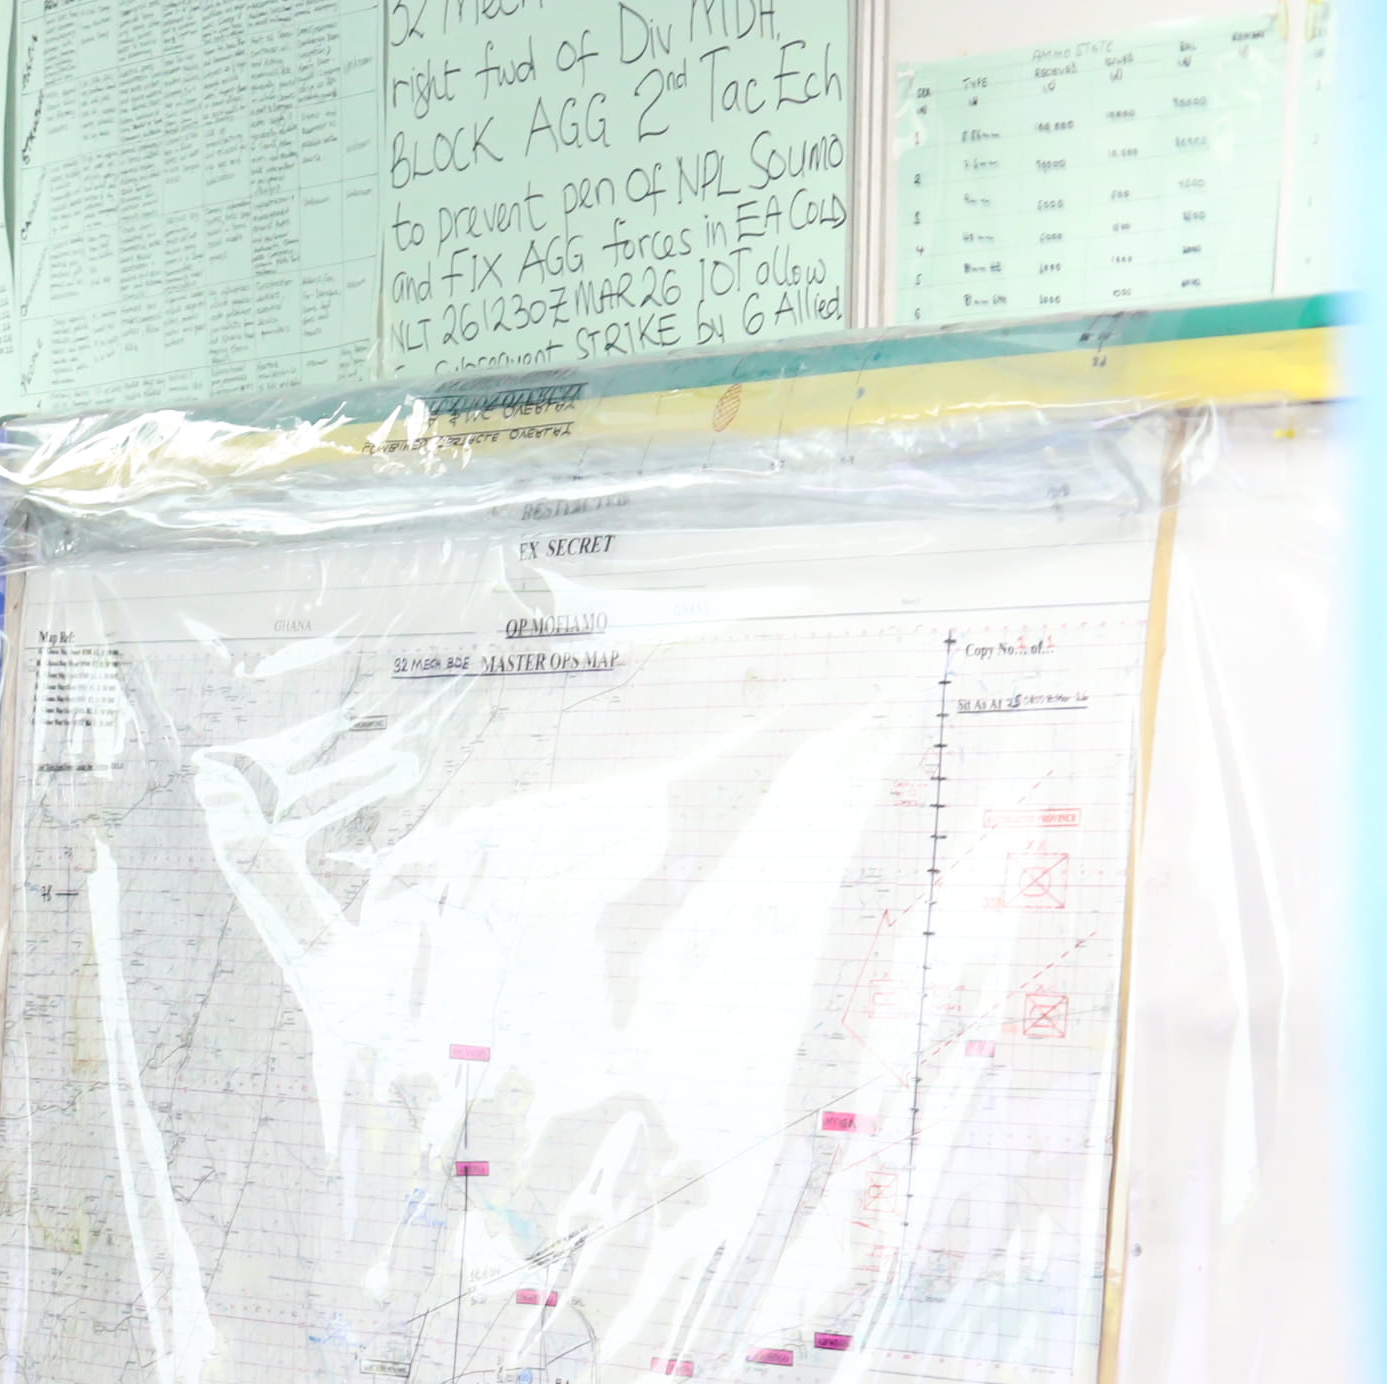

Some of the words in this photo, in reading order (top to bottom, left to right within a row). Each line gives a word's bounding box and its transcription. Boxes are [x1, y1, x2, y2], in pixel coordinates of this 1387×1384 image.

[391, 58, 461, 119] right
[475, 35, 536, 99] fwd
[556, 30, 599, 87] of
[618, 2, 672, 63] Div
[390, 116, 504, 190] BLOCK
[525, 92, 611, 156] AGG
[700, 47, 765, 123] Tac
[774, 40, 842, 111] Ech
[914, 174, 921, 185] 2
[391, 220, 426, 252] to
[437, 193, 547, 257] prevent
[562, 175, 618, 235] pen
[392, 271, 432, 304] and
[441, 248, 503, 290] FIX
[517, 235, 584, 285] AGG
[602, 218, 692, 267] forces
[704, 210, 726, 247] in
[736, 192, 791, 243] EA
[916, 246, 924, 255] 4
[391, 318, 431, 352] NLT
[572, 274, 636, 314] MAR
[639, 270, 682, 307] 26
[575, 313, 682, 360] STRIKE
[696, 299, 725, 344] by
[742, 293, 765, 335] 6
[519, 542, 539, 561] EX
[546, 535, 615, 557] SECRET
[274, 620, 312, 632] GHANA
[506, 619, 527, 638] OP
[481, 654, 546, 673] MASTER
[550, 653, 579, 670] OPS
[588, 650, 620, 669] MAP
[965, 644, 994, 660] Copy
